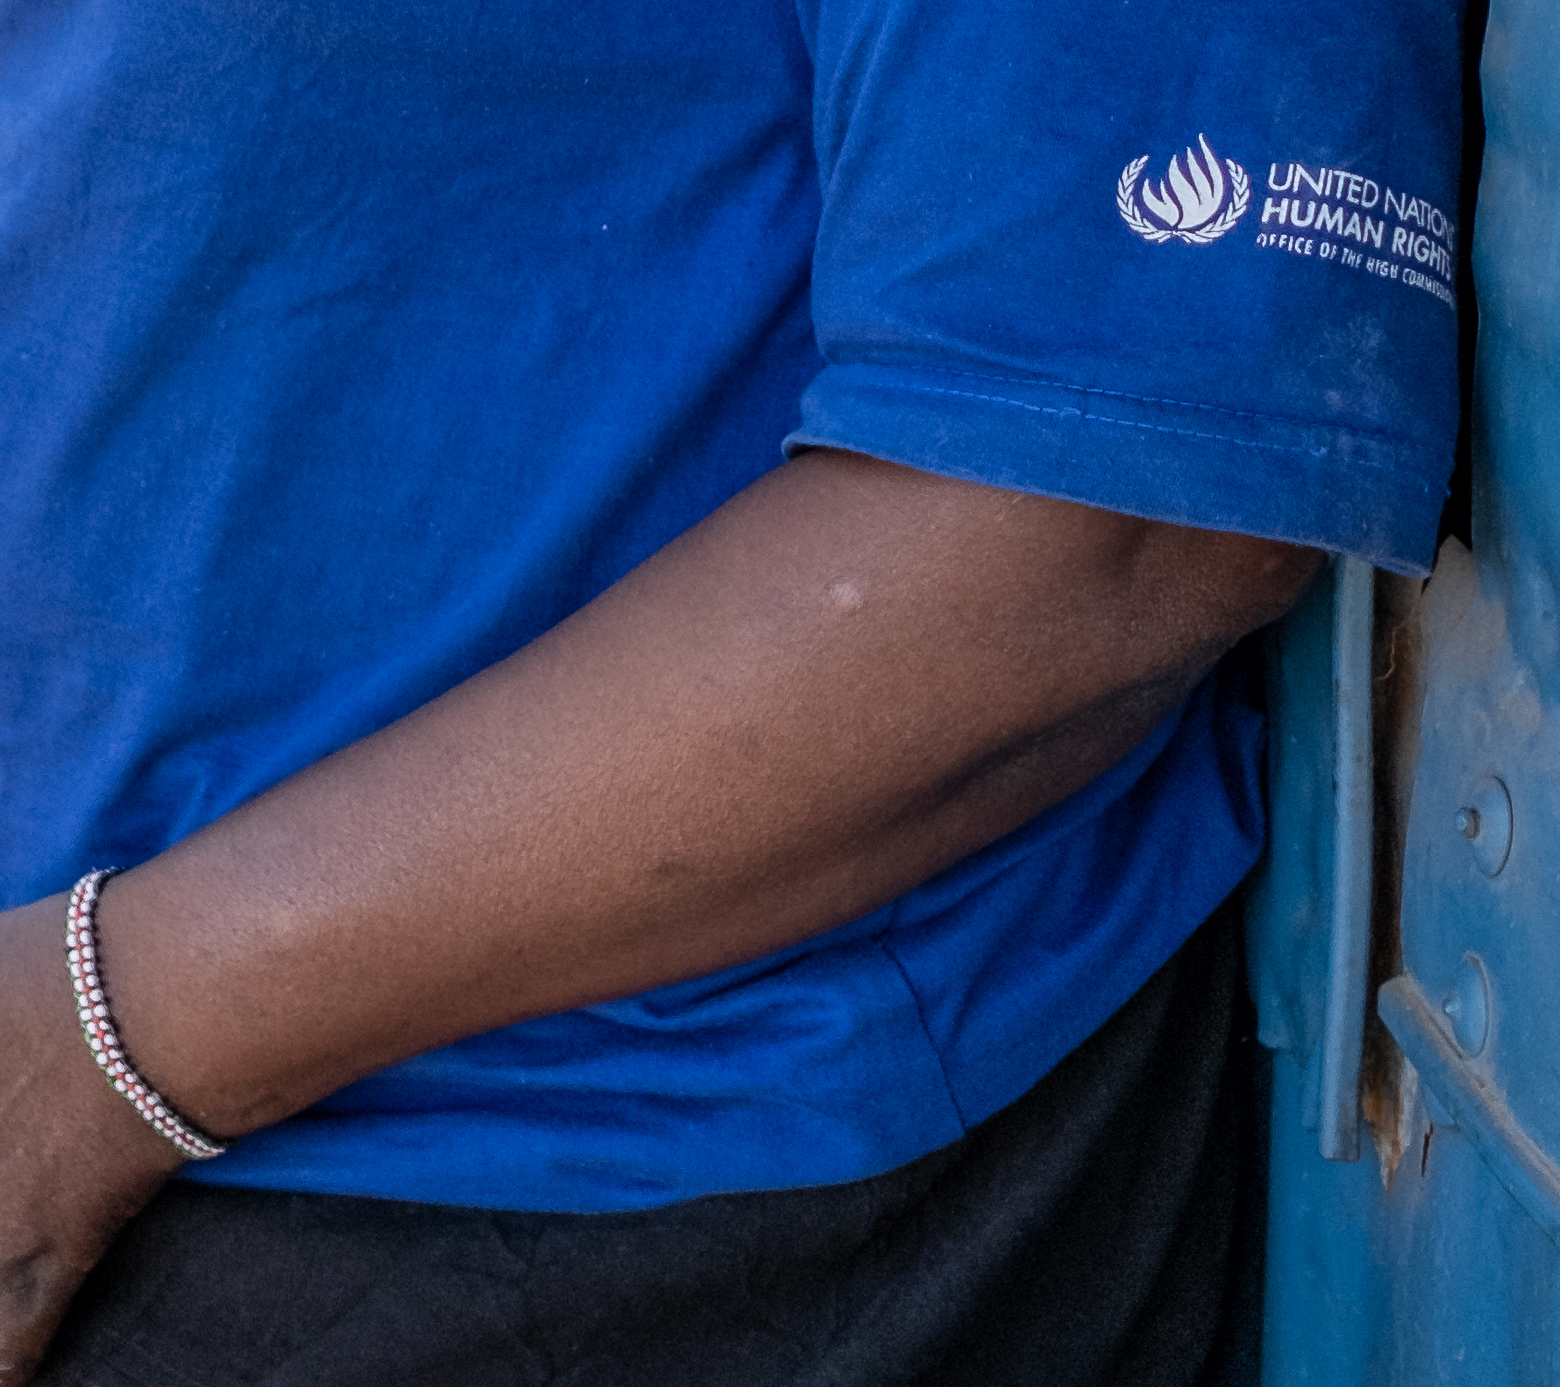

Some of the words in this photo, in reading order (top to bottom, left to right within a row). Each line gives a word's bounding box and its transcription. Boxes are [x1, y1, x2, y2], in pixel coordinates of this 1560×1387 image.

[1261, 197, 1384, 249] HUMAN
[1391, 226, 1452, 281] RIGHTS
[1267, 162, 1380, 209] UNITED
[1383, 186, 1455, 252] NATION
[1256, 232, 1314, 256] OFFICE
[1318, 241, 1339, 260] OF
[1341, 247, 1363, 269] THE
[1366, 256, 1399, 279] HIGH
